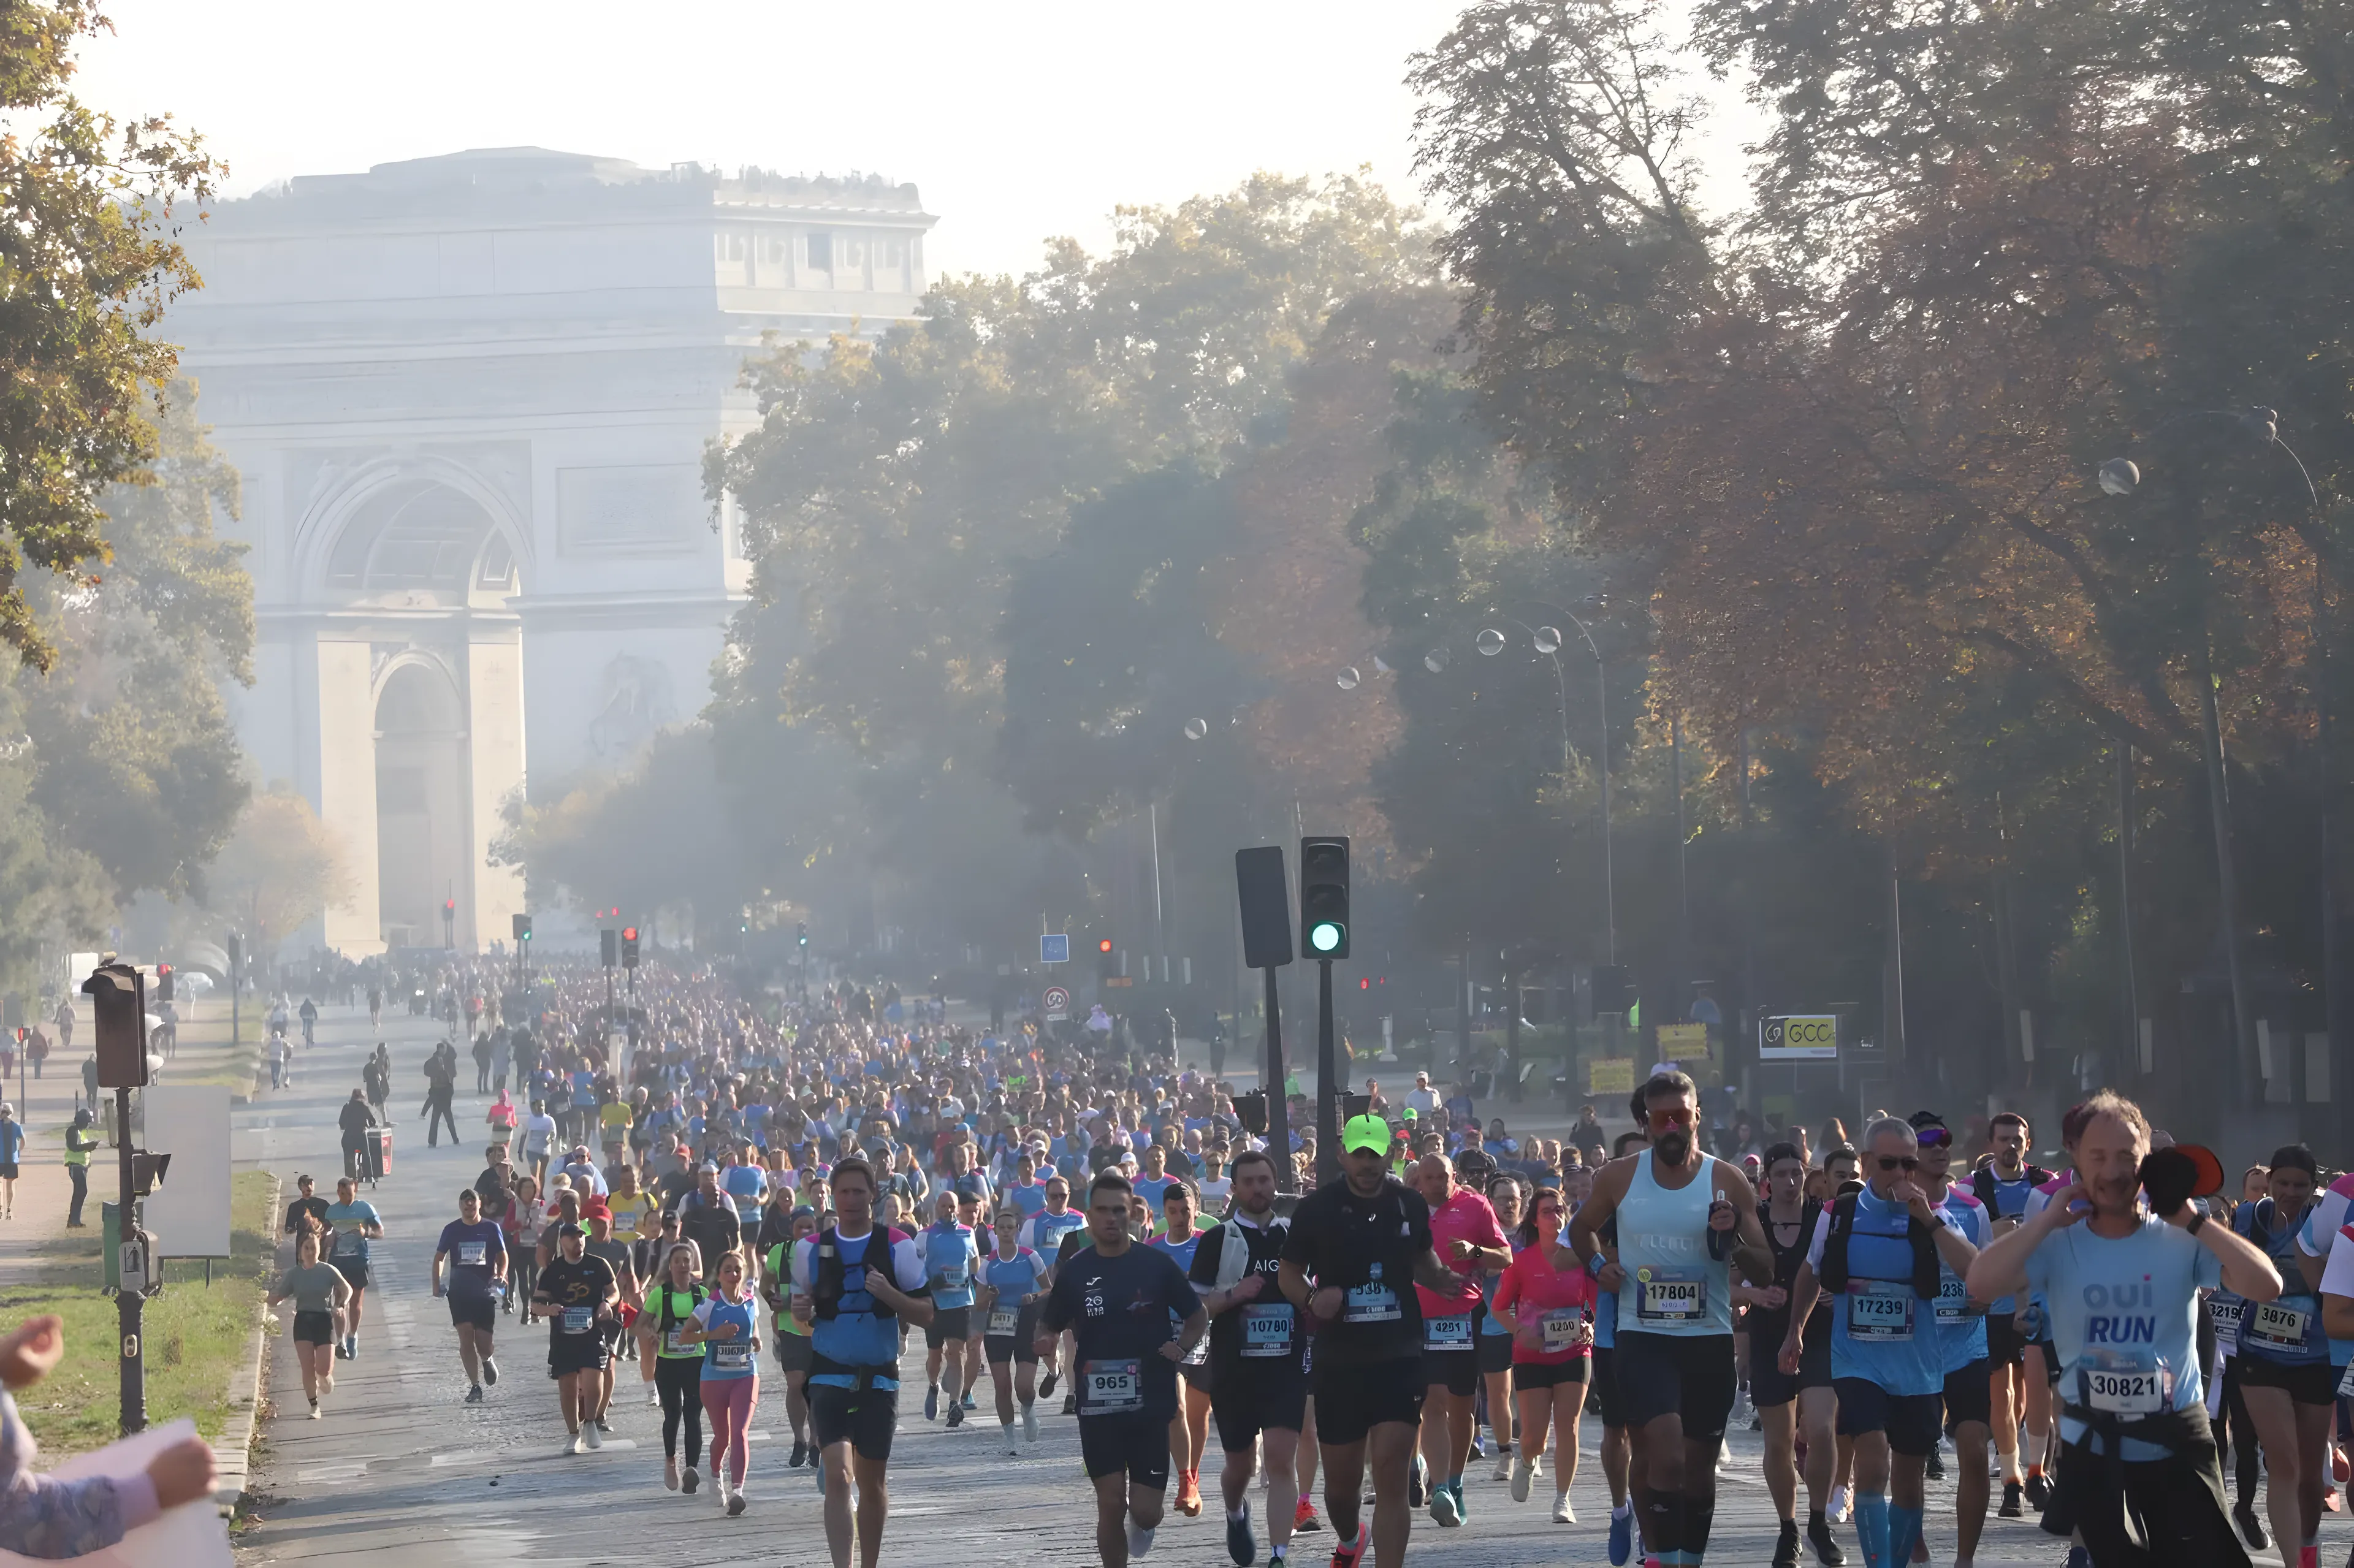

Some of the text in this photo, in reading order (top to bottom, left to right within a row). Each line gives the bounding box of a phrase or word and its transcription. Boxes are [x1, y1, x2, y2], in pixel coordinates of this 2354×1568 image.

[1650, 1285, 1696, 1300] 17804
[1857, 1298, 1903, 1315] 17239
[2088, 1315, 2156, 1344] RUN
[2094, 1375, 2155, 1397] 30821
